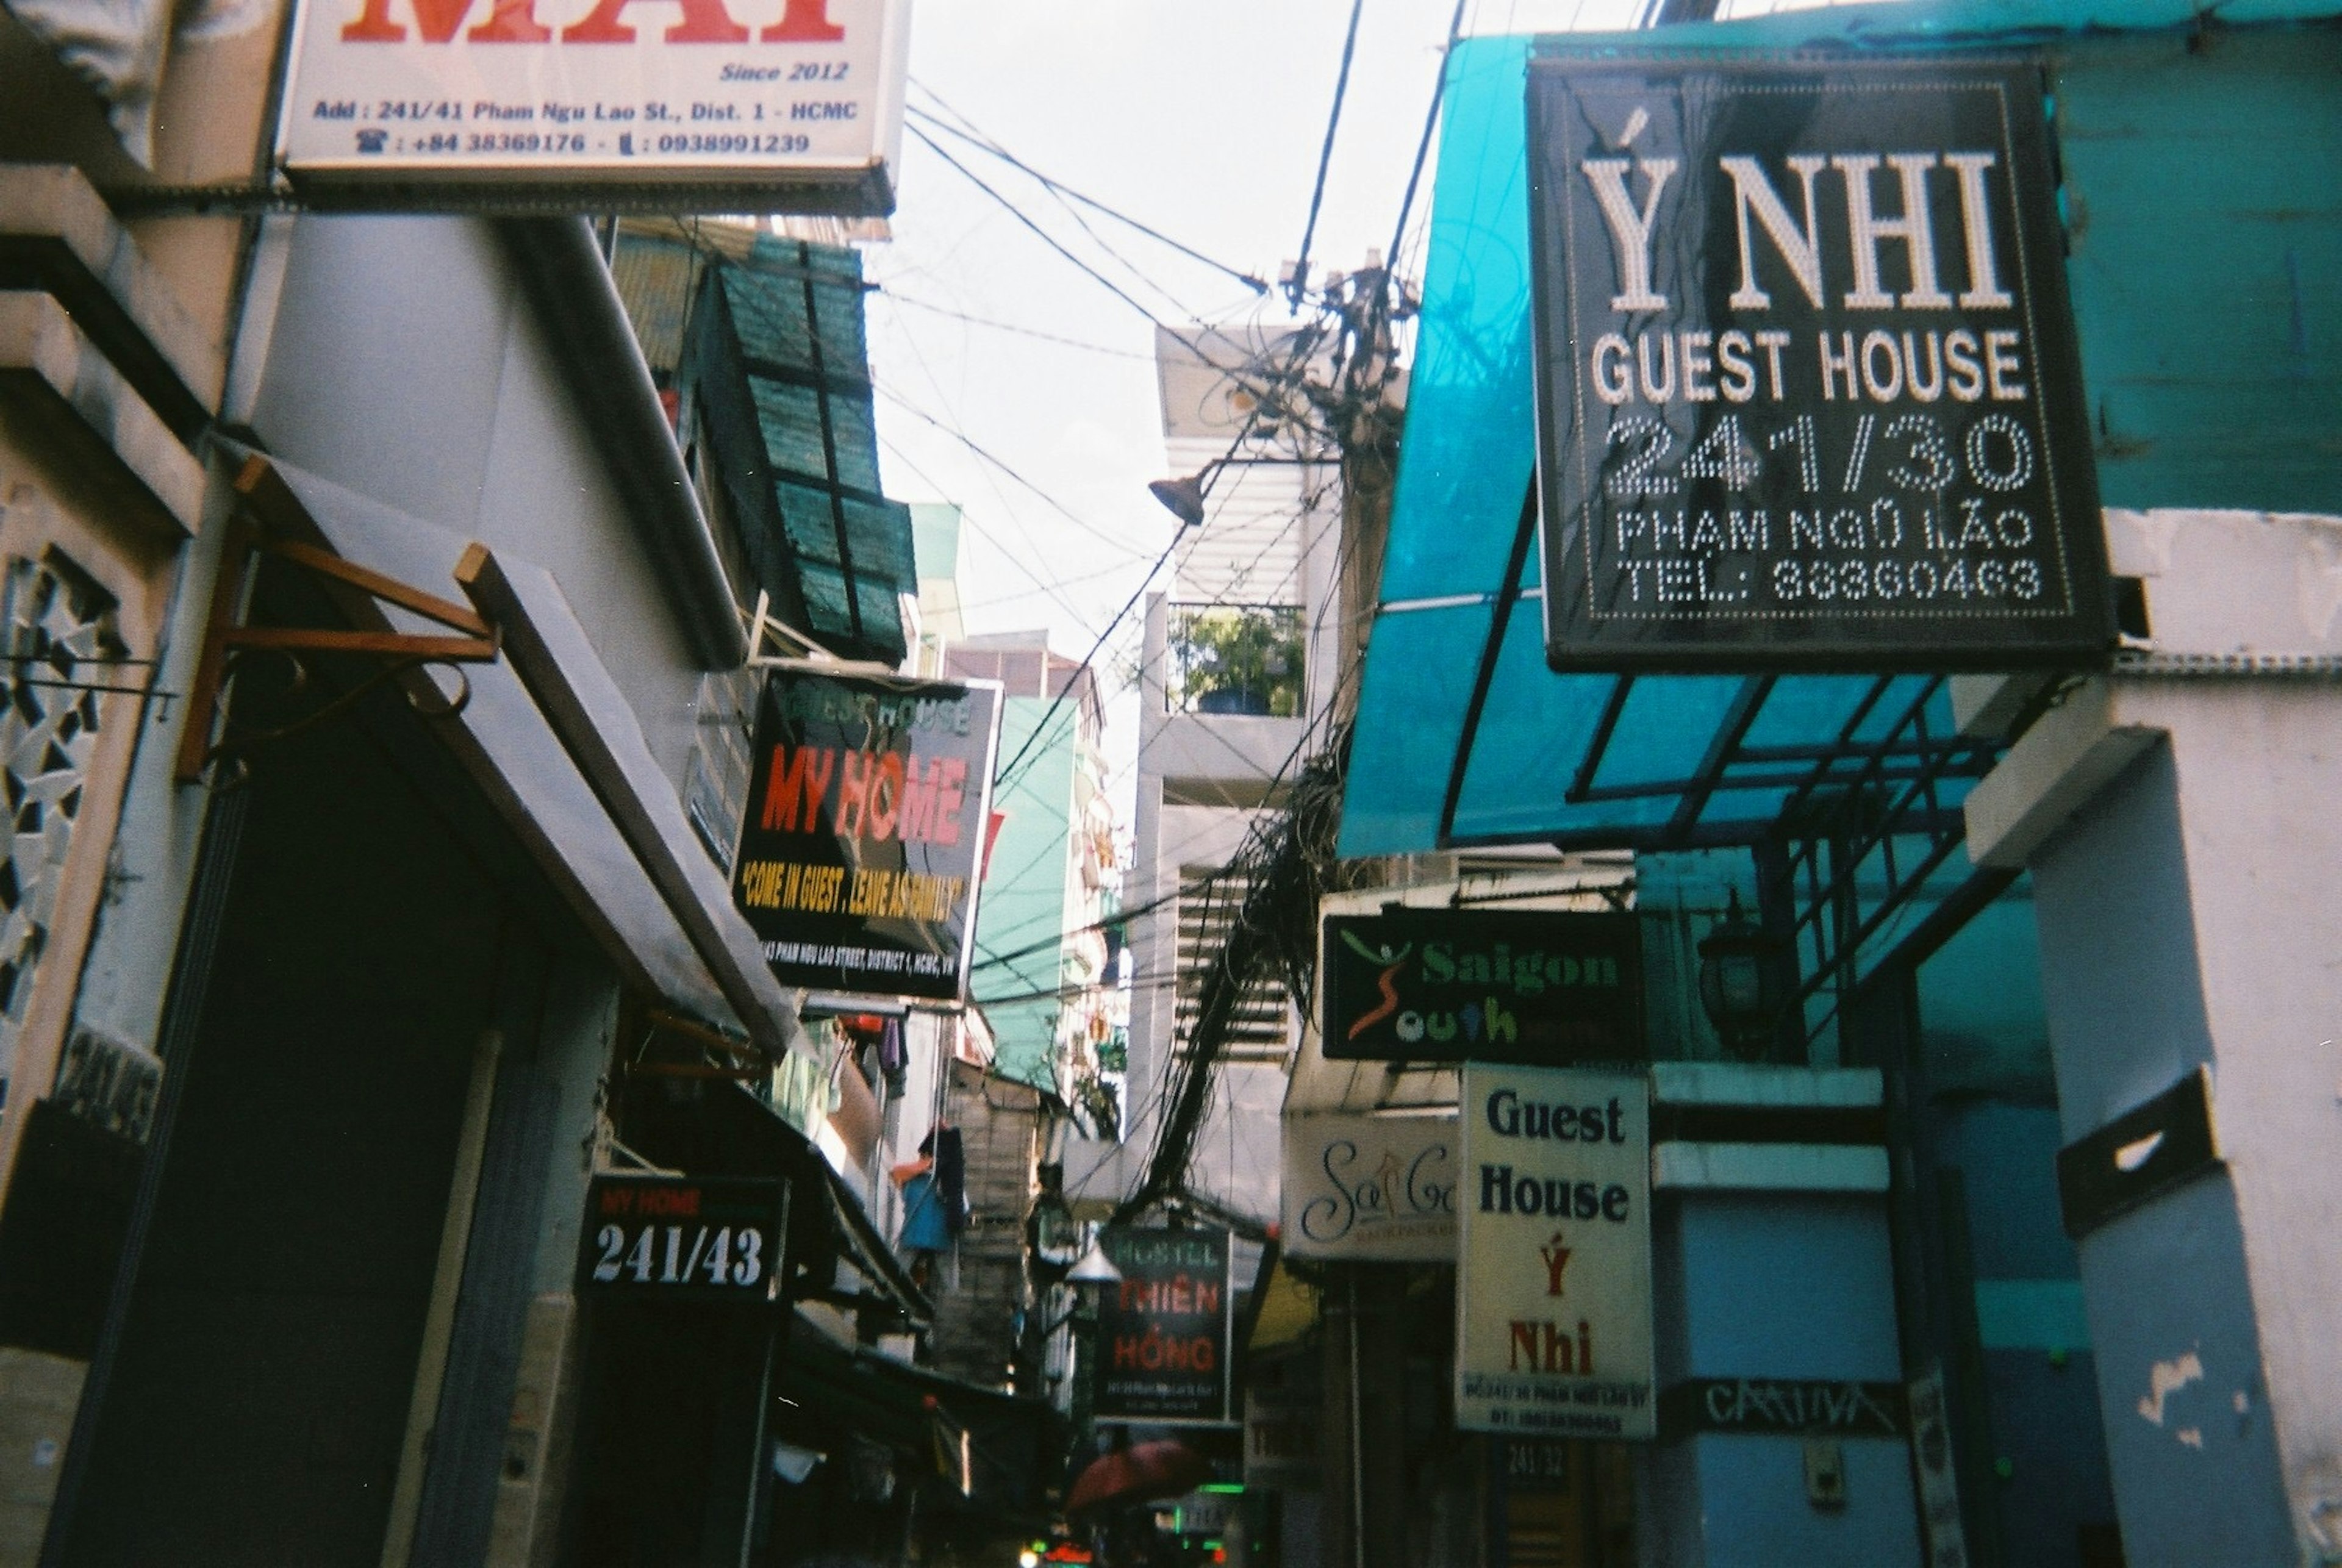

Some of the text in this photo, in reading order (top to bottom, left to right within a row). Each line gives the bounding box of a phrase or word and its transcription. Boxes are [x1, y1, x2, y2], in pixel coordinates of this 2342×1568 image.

[720, 62, 850, 81] Since 2012
[313, 101, 356, 120] Add
[378, 101, 462, 120] 241/41
[473, 101, 534, 120] Pham
[542, 101, 586, 123] Ngu
[594, 102, 635, 121] Lao
[691, 101, 741, 120] Dist.
[753, 102, 764, 120] 1
[791, 101, 858, 121] HCMC
[414, 134, 458, 152] +84
[468, 133, 586, 152] 38369176
[658, 135, 811, 153] 0938991239
[1581, 105, 2015, 312] Ý NHI
[1591, 329, 2029, 404] GUEST HOUSE
[1604, 413, 2035, 494] 241/30
[1772, 557, 2041, 601] 38360463
[761, 742, 968, 847] MY HOME
[782, 862, 801, 910] IN
[849, 865, 891, 918] LEAVE
[817, 945, 835, 967] LAO
[1422, 942, 1618, 996] Saigon
[1486, 1087, 1627, 1145] Guest
[1479, 1164, 1630, 1223] House
[593, 1223, 762, 1287] 241/43
[1541, 1231, 1573, 1297] Ý
[1508, 1319, 1596, 1377] Nhi
